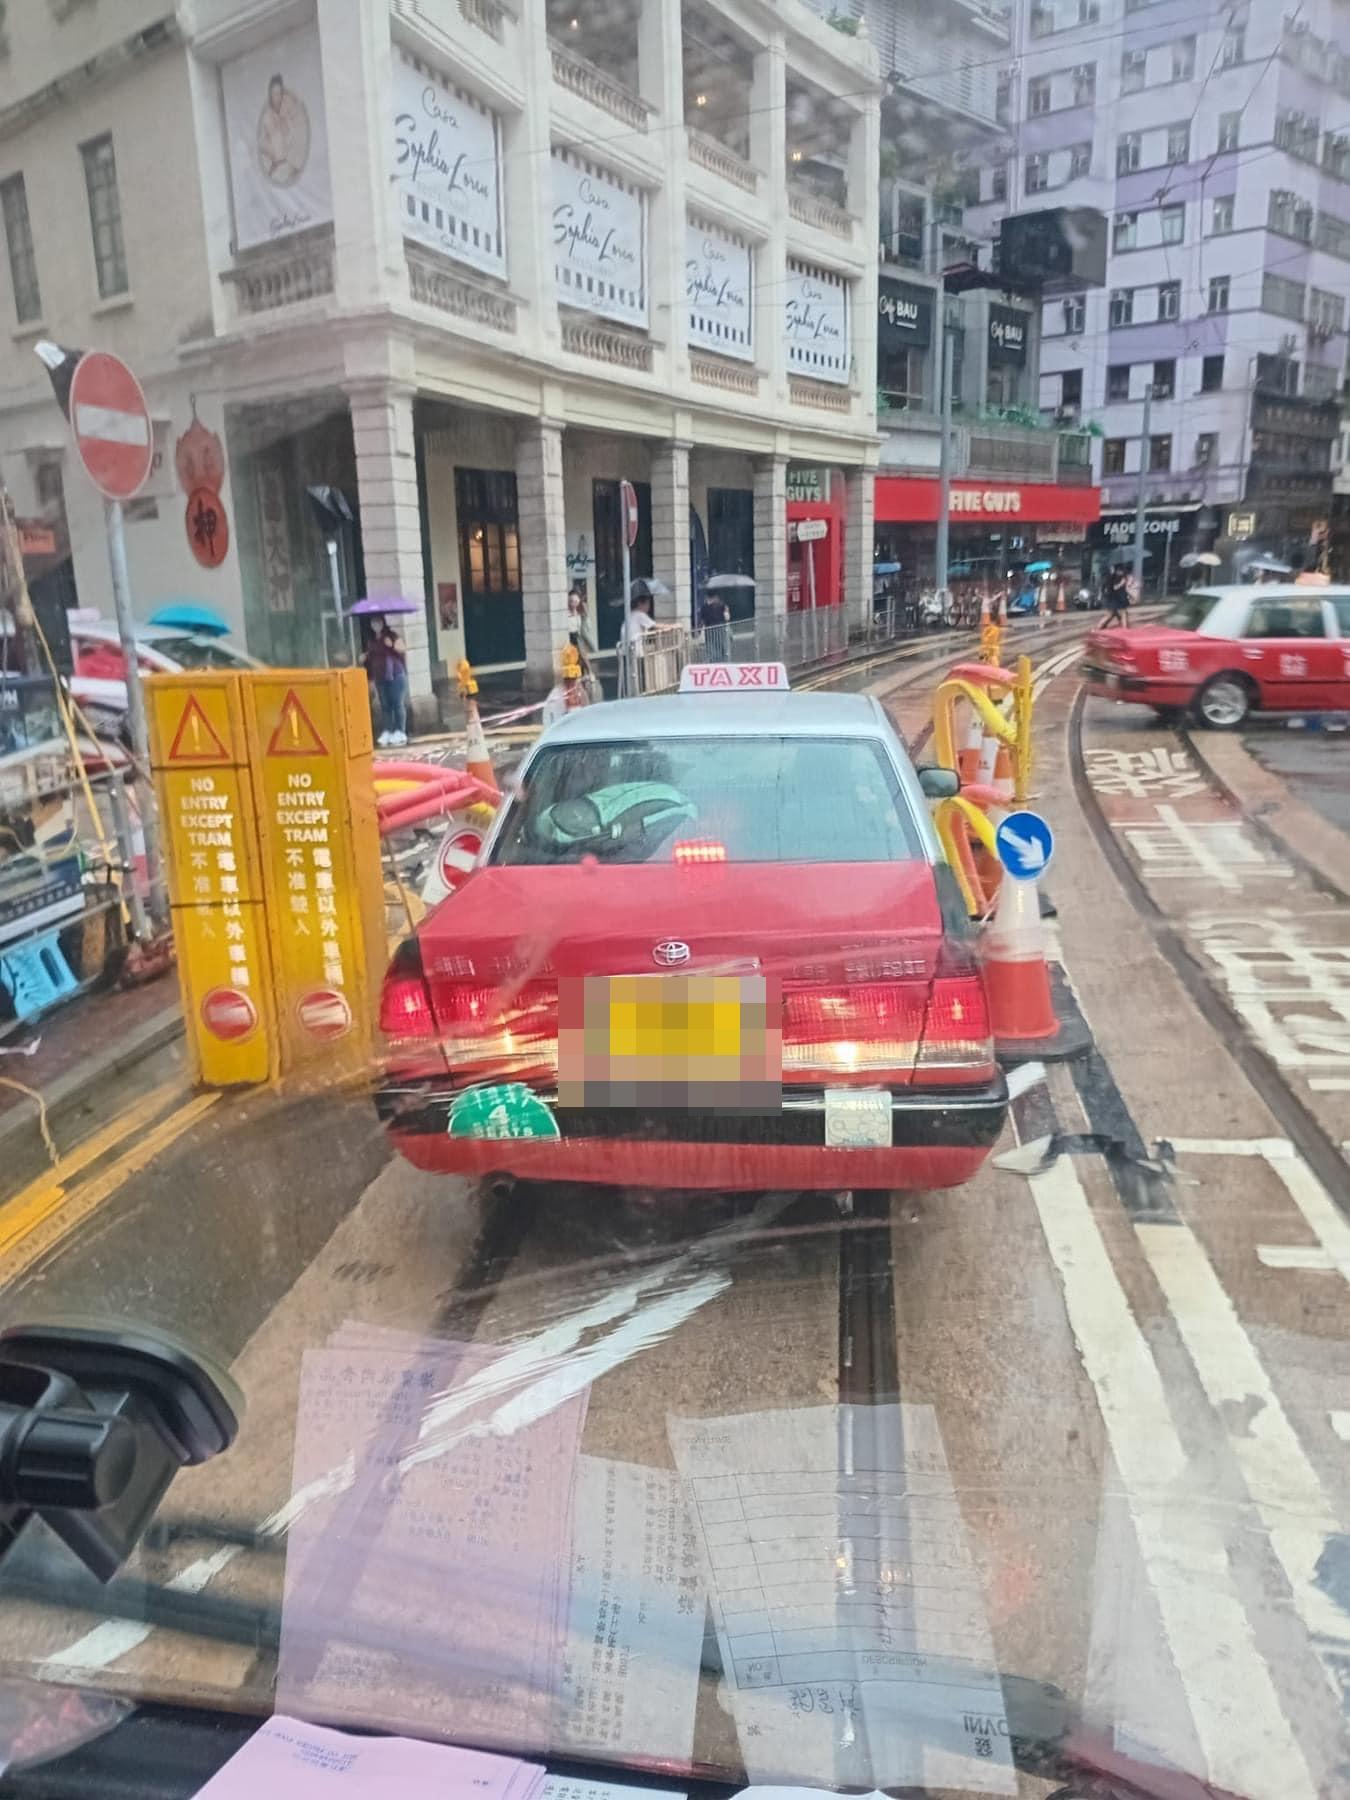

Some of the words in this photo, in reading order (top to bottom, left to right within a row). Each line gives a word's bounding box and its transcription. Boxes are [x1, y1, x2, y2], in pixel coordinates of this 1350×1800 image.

[395, 114, 450, 181] Sophia
[448, 154, 489, 198] Loren
[553, 205, 599, 257] Sophia
[599, 229, 635, 262] Loren
[897, 302, 918, 319] BAU
[1004, 325, 1023, 342] BAU
[789, 470, 818, 486] FIVE
[786, 486, 821, 501] GUYS
[949, 490, 981, 512] FIVE
[983, 490, 1021, 513] GUYS
[689, 666, 778, 686] TAXI
[191, 776, 215, 792] NO
[287, 773, 312, 788] NO
[181, 795, 228, 811] ENTRY
[277, 791, 326, 807] ENTRY
[180, 813, 233, 830] EXCEPT
[276, 809, 330, 825] EXCEPT
[188, 830, 233, 847] TRAM
[283, 828, 329, 843] TRAM
